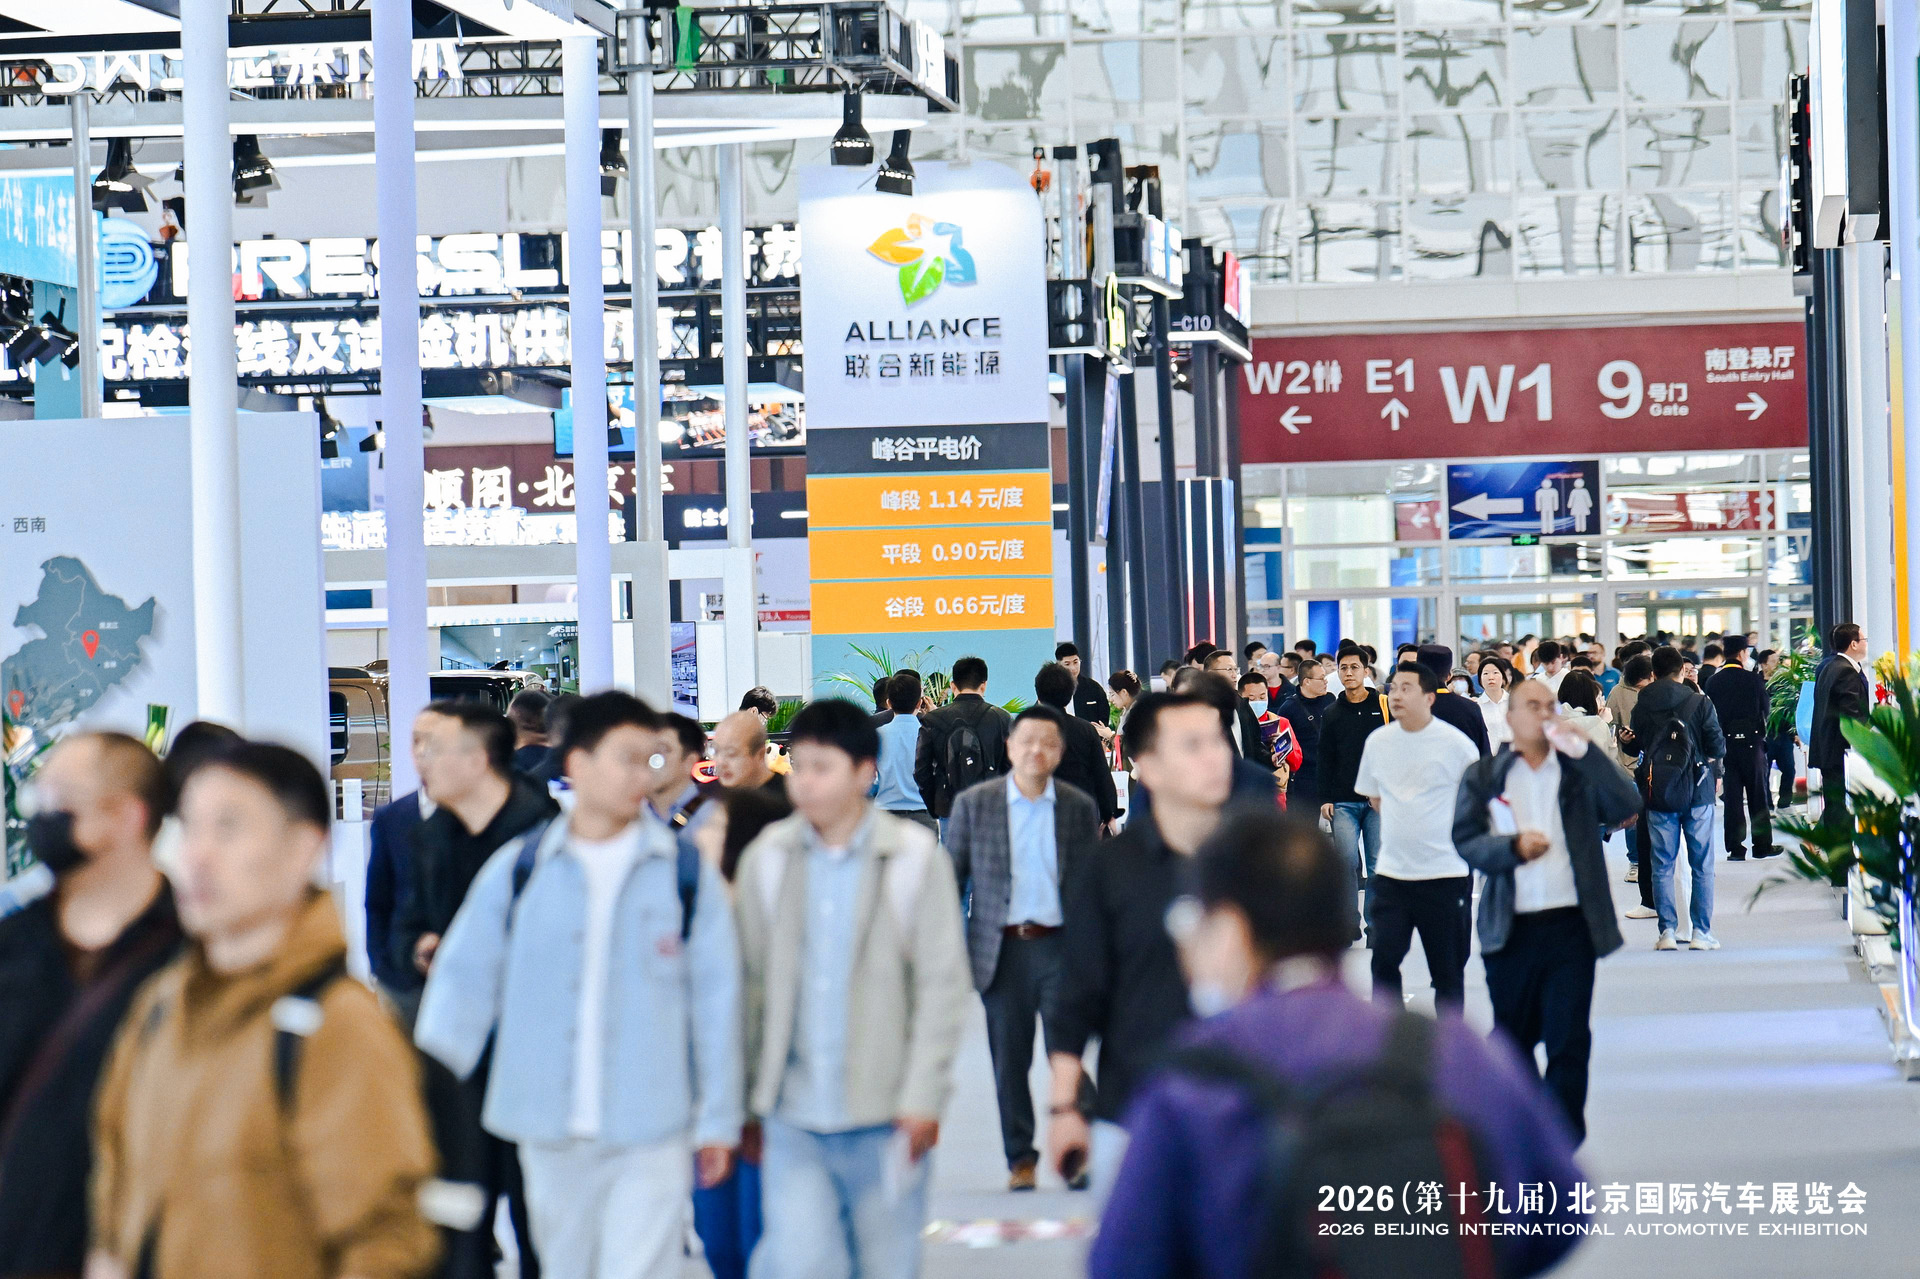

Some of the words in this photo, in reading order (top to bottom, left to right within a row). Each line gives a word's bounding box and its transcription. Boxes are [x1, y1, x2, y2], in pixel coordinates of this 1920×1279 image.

[845, 318, 1001, 342] ALLIANCE
[103, 307, 673, 381] 检线及试验机供商
[845, 351, 1000, 379] 联合新能源
[1705, 345, 1795, 371] 南登录厅
[1243, 361, 1311, 394] W2
[1366, 358, 1415, 393] E1
[1706, 372, 1739, 383] South
[1740, 370, 1771, 383] Entry
[1771, 369, 1794, 380] Hall
[1439, 363, 1552, 424] W1
[1597, 360, 1644, 419] 9
[1648, 382, 1688, 402] 号门
[1649, 404, 1689, 416] Gate
[871, 435, 982, 461] 峰谷平电价
[881, 490, 920, 511] 峰段
[929, 490, 973, 508] 1.14
[978, 486, 1024, 510] 元/度
[13, 517, 46, 533] 西南
[882, 543, 921, 565] 平段
[885, 596, 925, 618] 谷段
